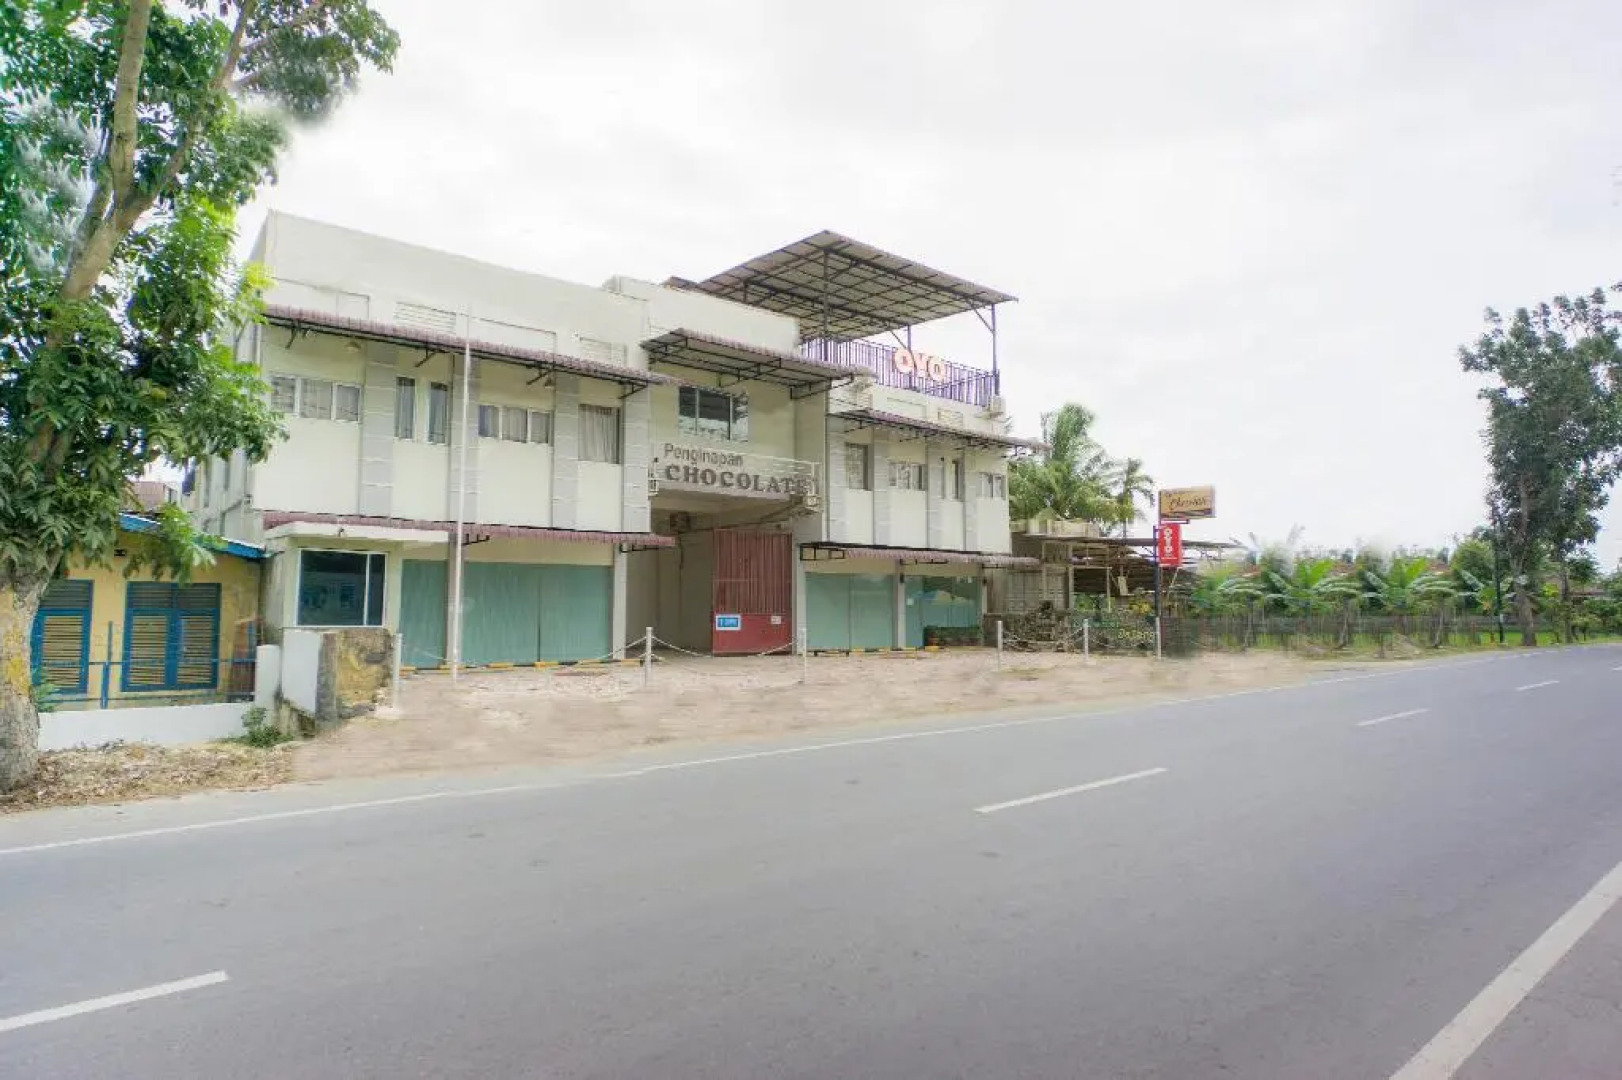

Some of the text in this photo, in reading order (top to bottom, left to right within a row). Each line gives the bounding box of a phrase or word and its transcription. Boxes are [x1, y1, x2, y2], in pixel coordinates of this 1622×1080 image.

[894, 348, 947, 382] OYO
[664, 443, 744, 467] Penginapan
[664, 464, 808, 496] CHOCOLATE
[1163, 527, 1173, 552] OYO
